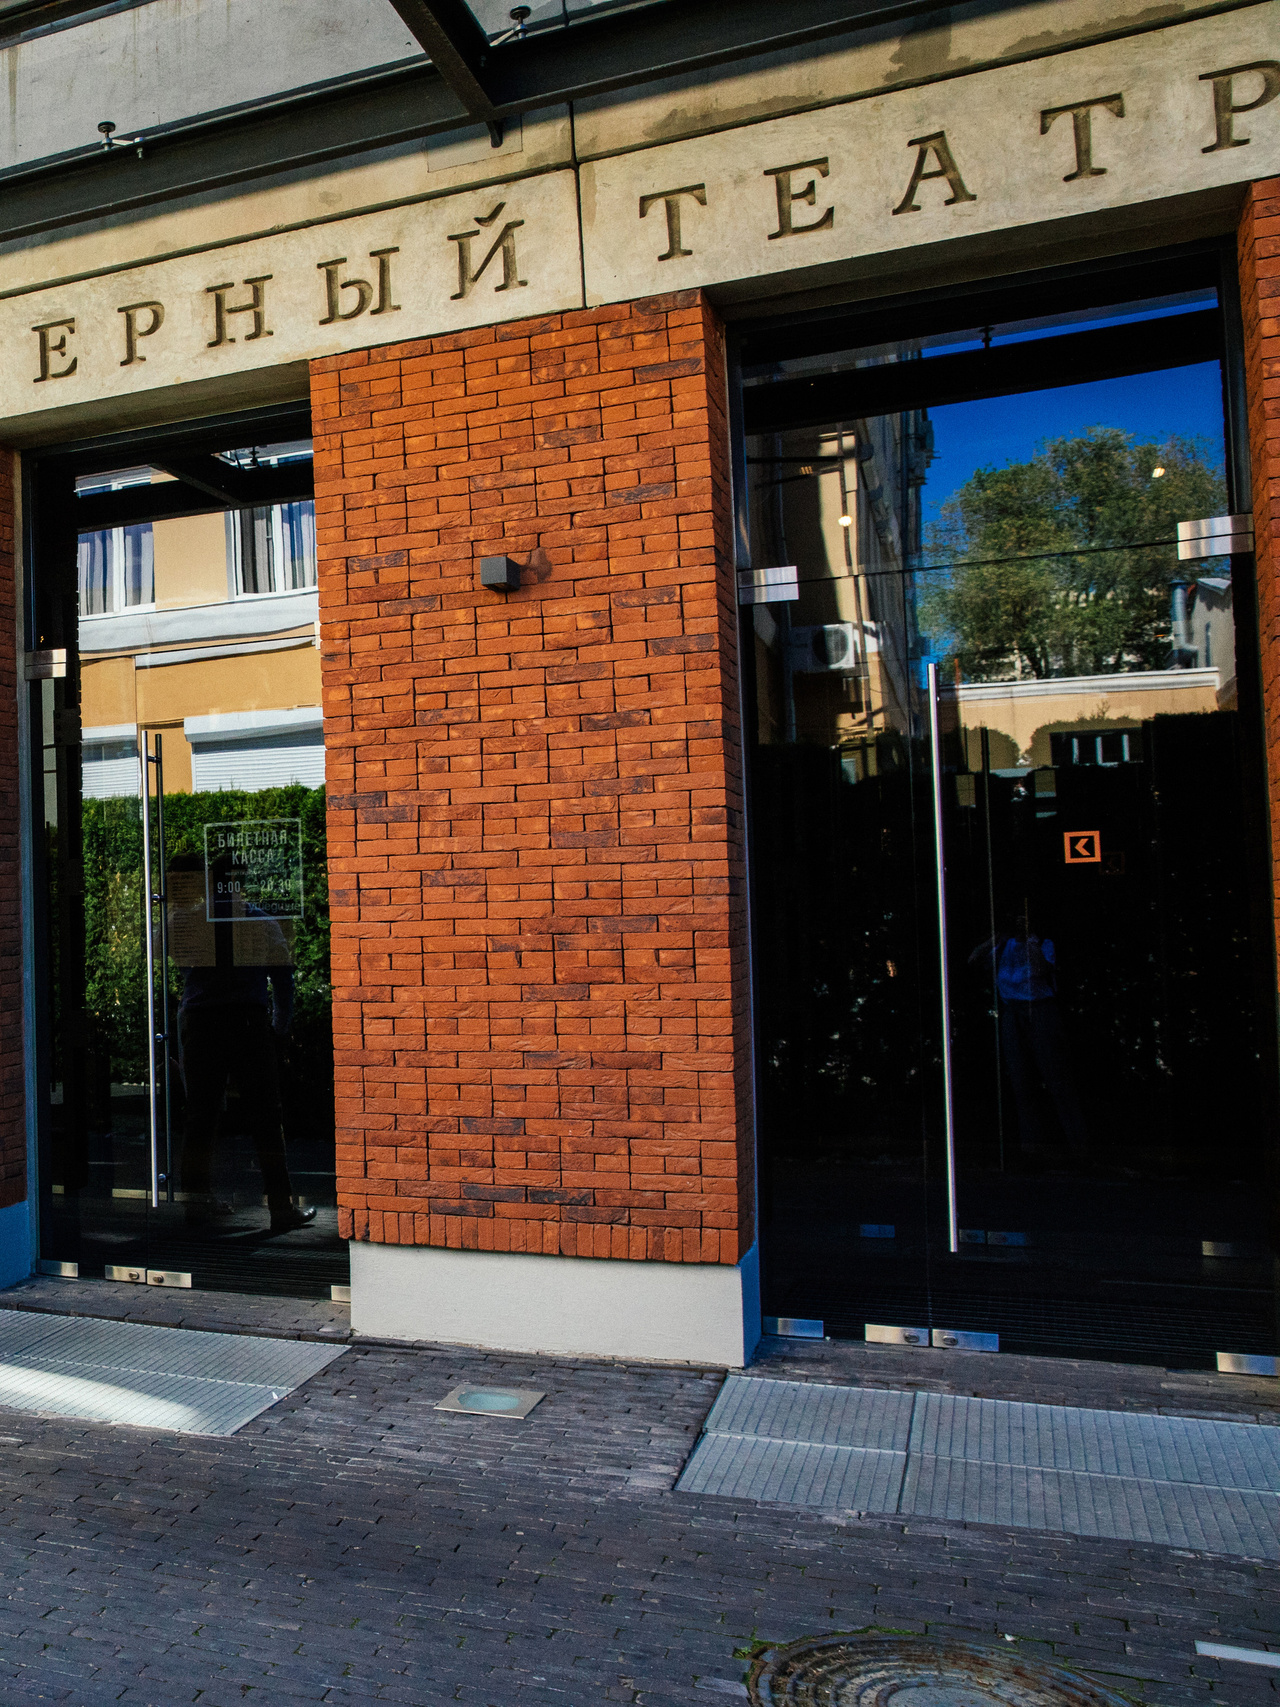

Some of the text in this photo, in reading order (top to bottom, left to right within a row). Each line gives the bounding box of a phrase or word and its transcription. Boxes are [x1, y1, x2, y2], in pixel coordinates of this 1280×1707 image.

[639, 59, 1280, 262] ТЕАТР
[217, 829, 287, 848] БИЛЕТНАЯ
[231, 848, 274, 865] КАССА
[216, 880, 241, 894] 9:00
